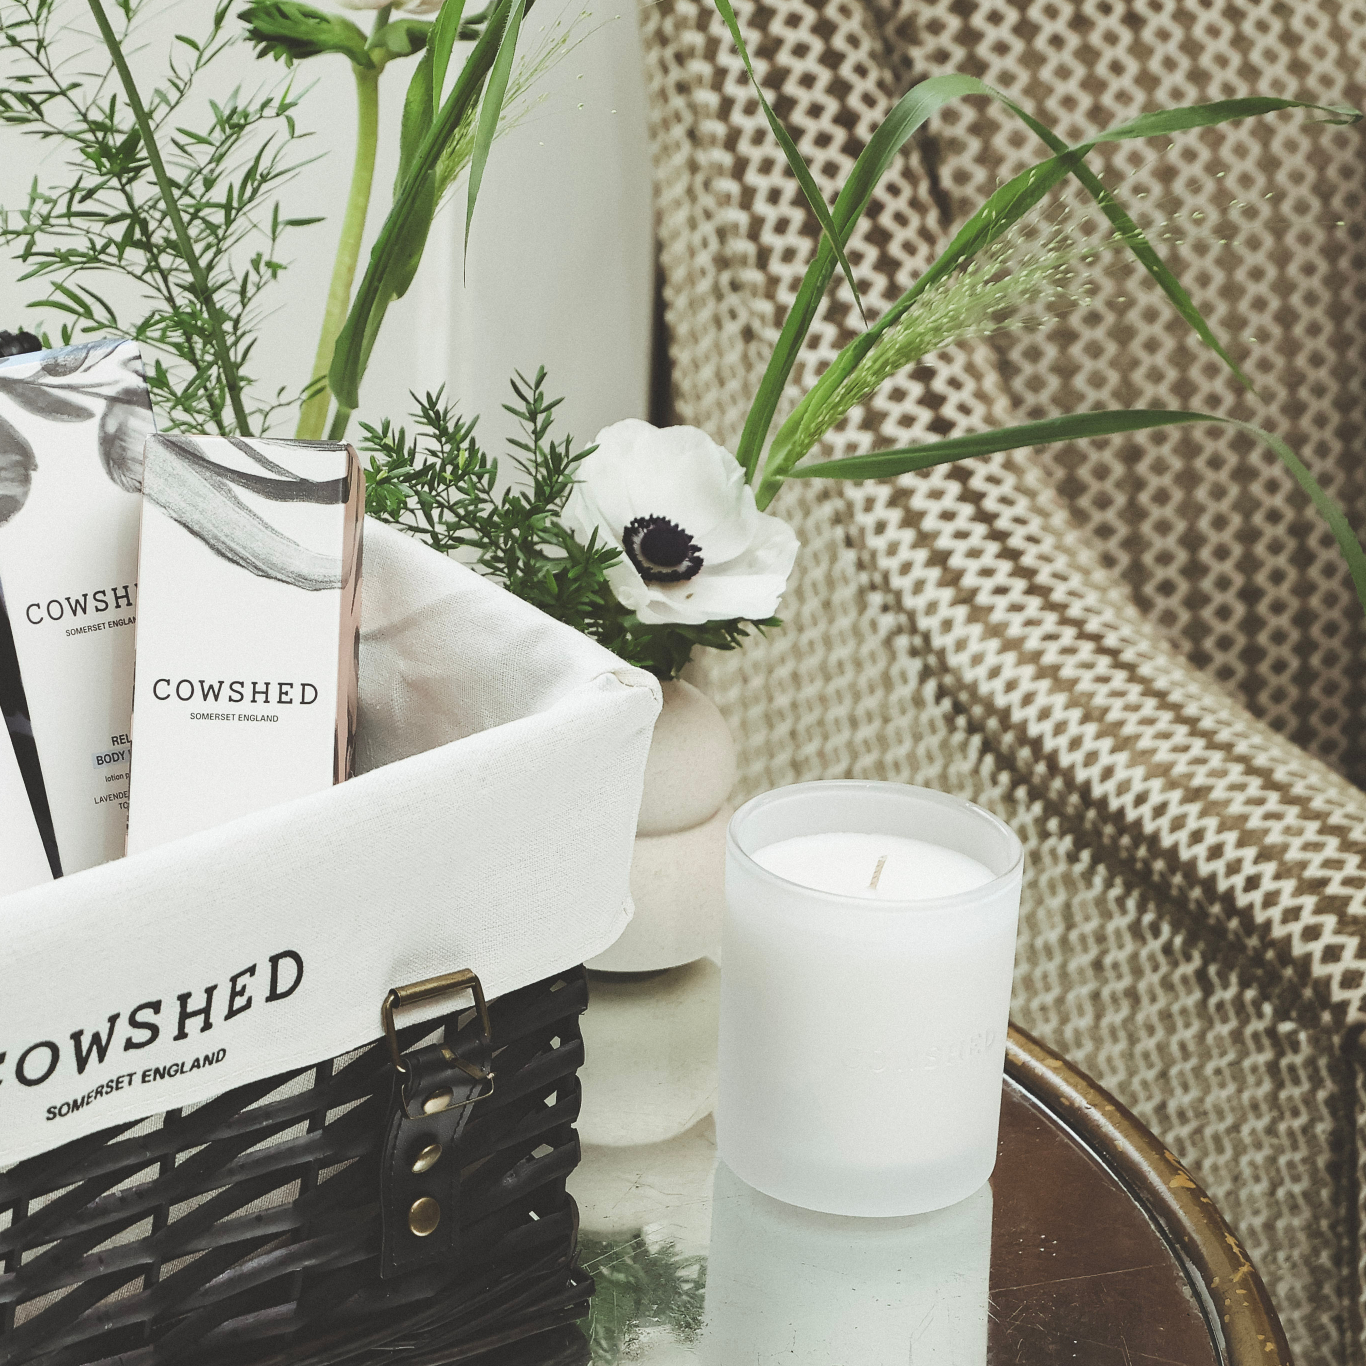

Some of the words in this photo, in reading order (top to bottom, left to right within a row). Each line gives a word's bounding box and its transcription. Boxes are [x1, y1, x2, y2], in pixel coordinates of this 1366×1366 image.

[26, 582, 138, 625] COWSH
[65, 621, 107, 637] SOMERSET
[108, 615, 136, 629] ENGLAN
[152, 678, 318, 705] COWSHED
[190, 712, 236, 722] SOMERSET
[238, 714, 279, 723] ENGLAND
[96, 750, 125, 766] BODY
[104, 773, 124, 783] lotion
[94, 790, 129, 805] LAVENDE
[841, 1027, 996, 1074] COSHED
[45, 1072, 137, 1122] SOMERSET
[141, 1047, 227, 1085] ENGLAND
